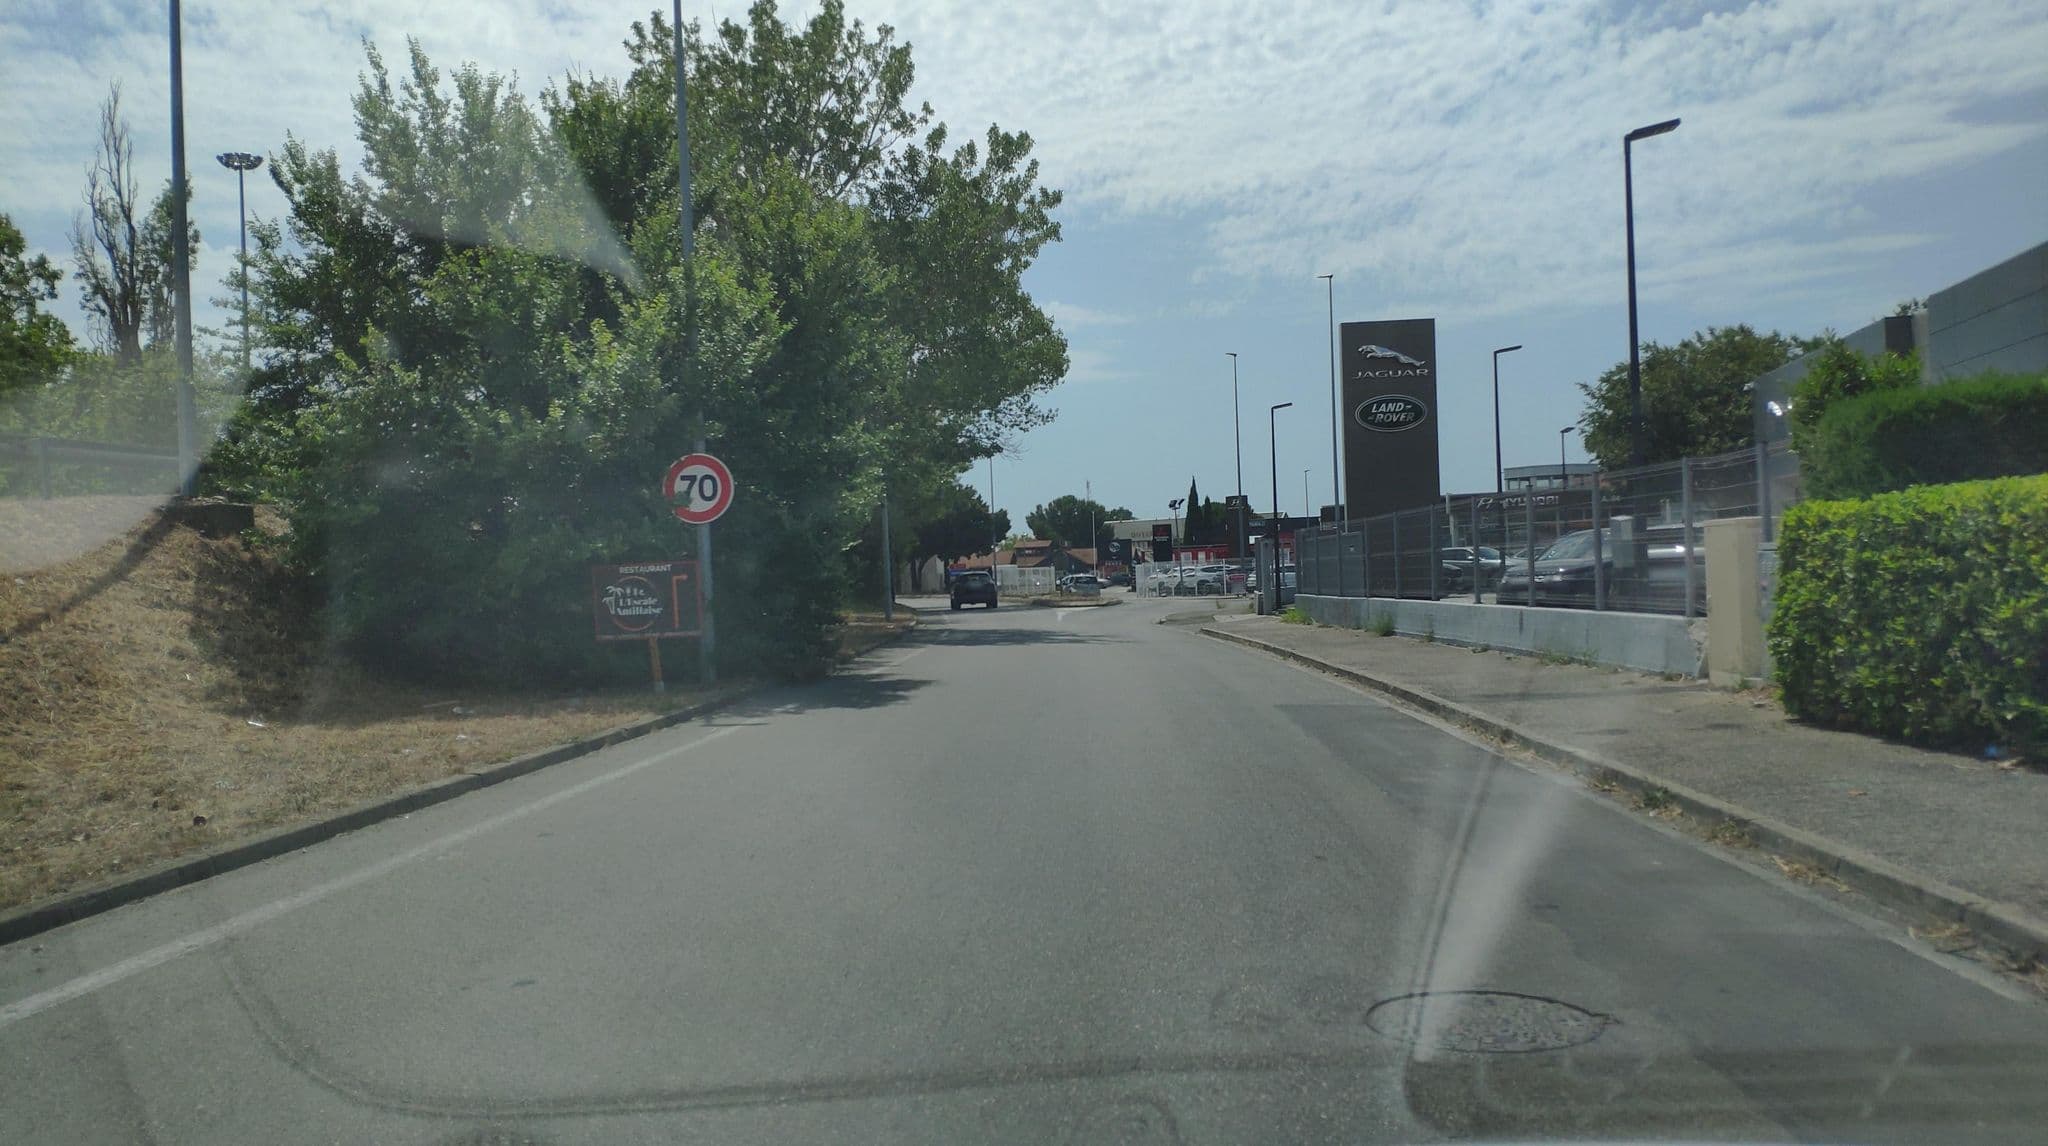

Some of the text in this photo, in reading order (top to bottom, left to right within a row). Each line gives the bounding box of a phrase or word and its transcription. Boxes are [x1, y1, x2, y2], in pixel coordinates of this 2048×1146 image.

[1352, 368, 1429, 380] JAGUAR
[680, 474, 718, 502] 70
[619, 564, 672, 574] RESTAURANT
